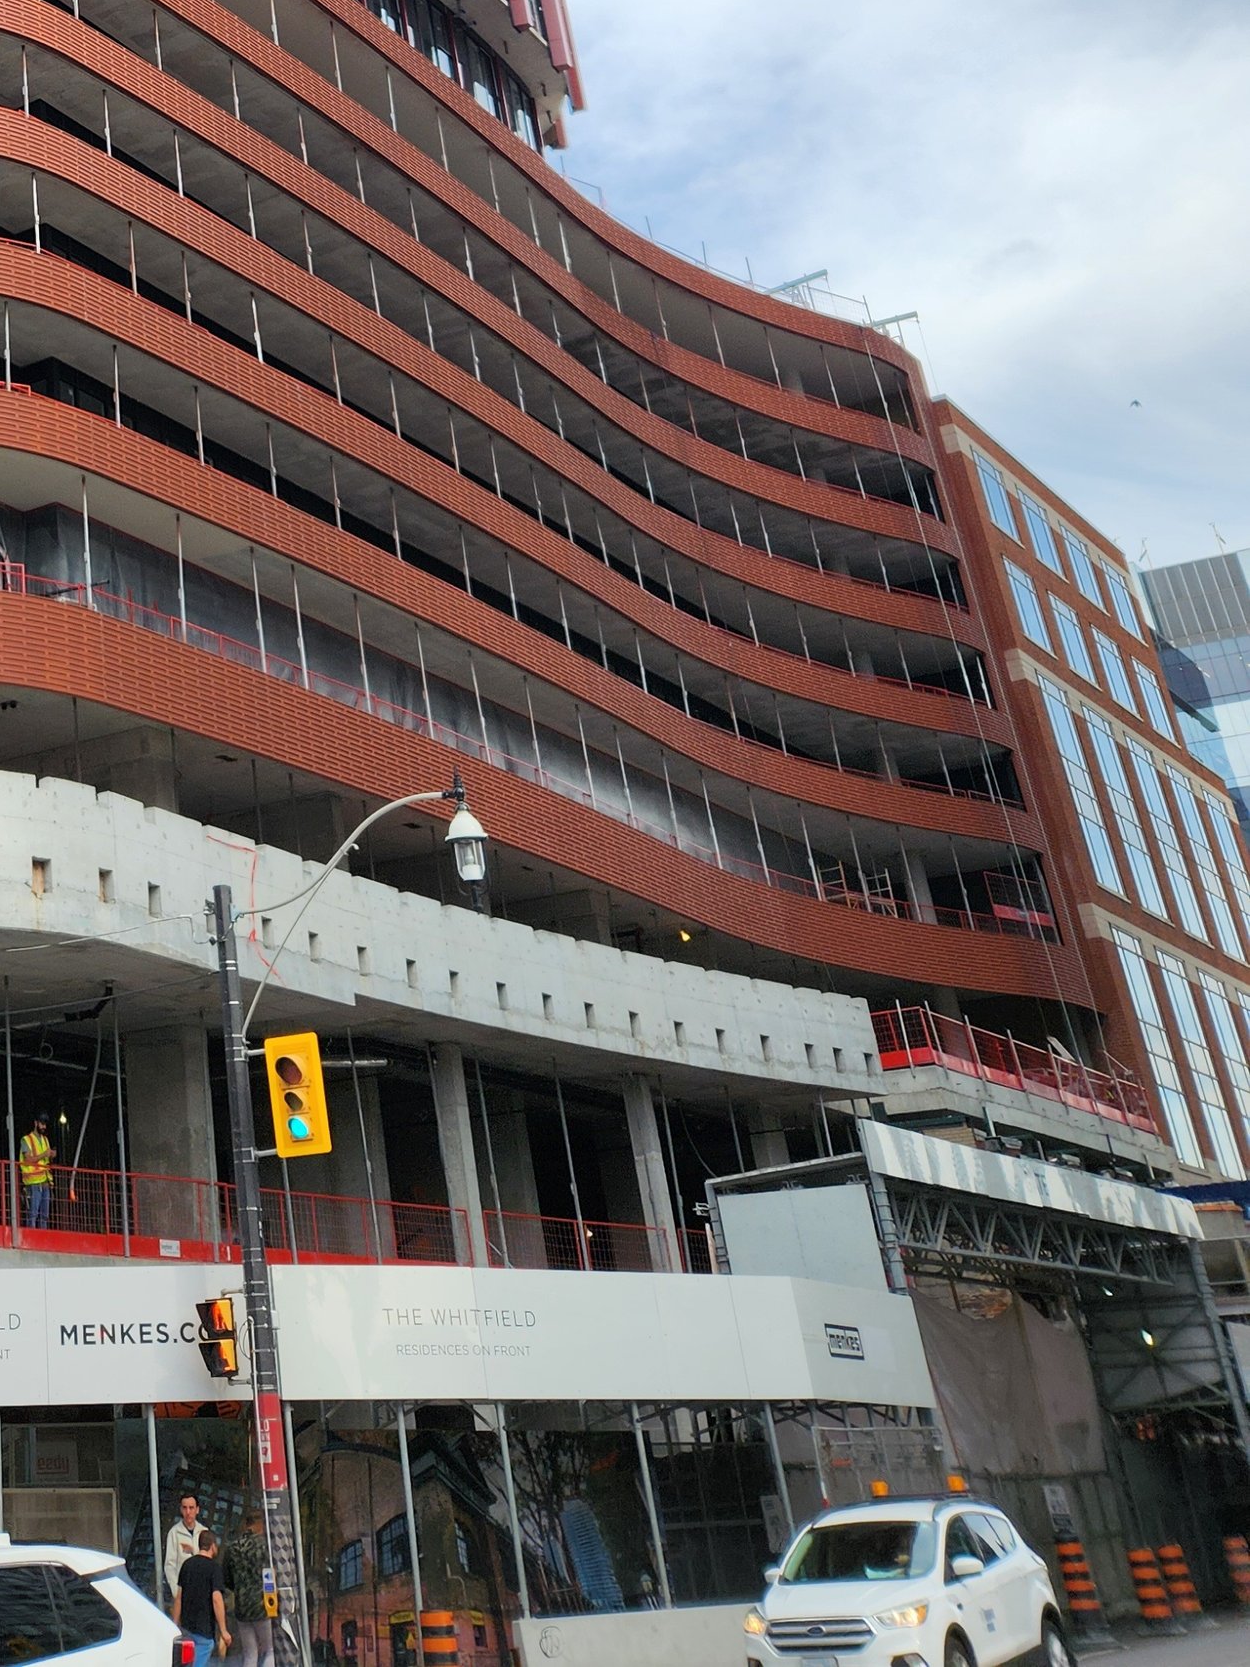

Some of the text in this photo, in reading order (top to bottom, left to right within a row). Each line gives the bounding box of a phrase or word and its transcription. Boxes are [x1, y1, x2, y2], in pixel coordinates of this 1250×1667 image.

[382, 1308, 537, 1327] THE WHITFIELD
[59, 1322, 209, 1346] MENKES.C
[396, 1344, 531, 1356] RESIDENCES ON FRONT
